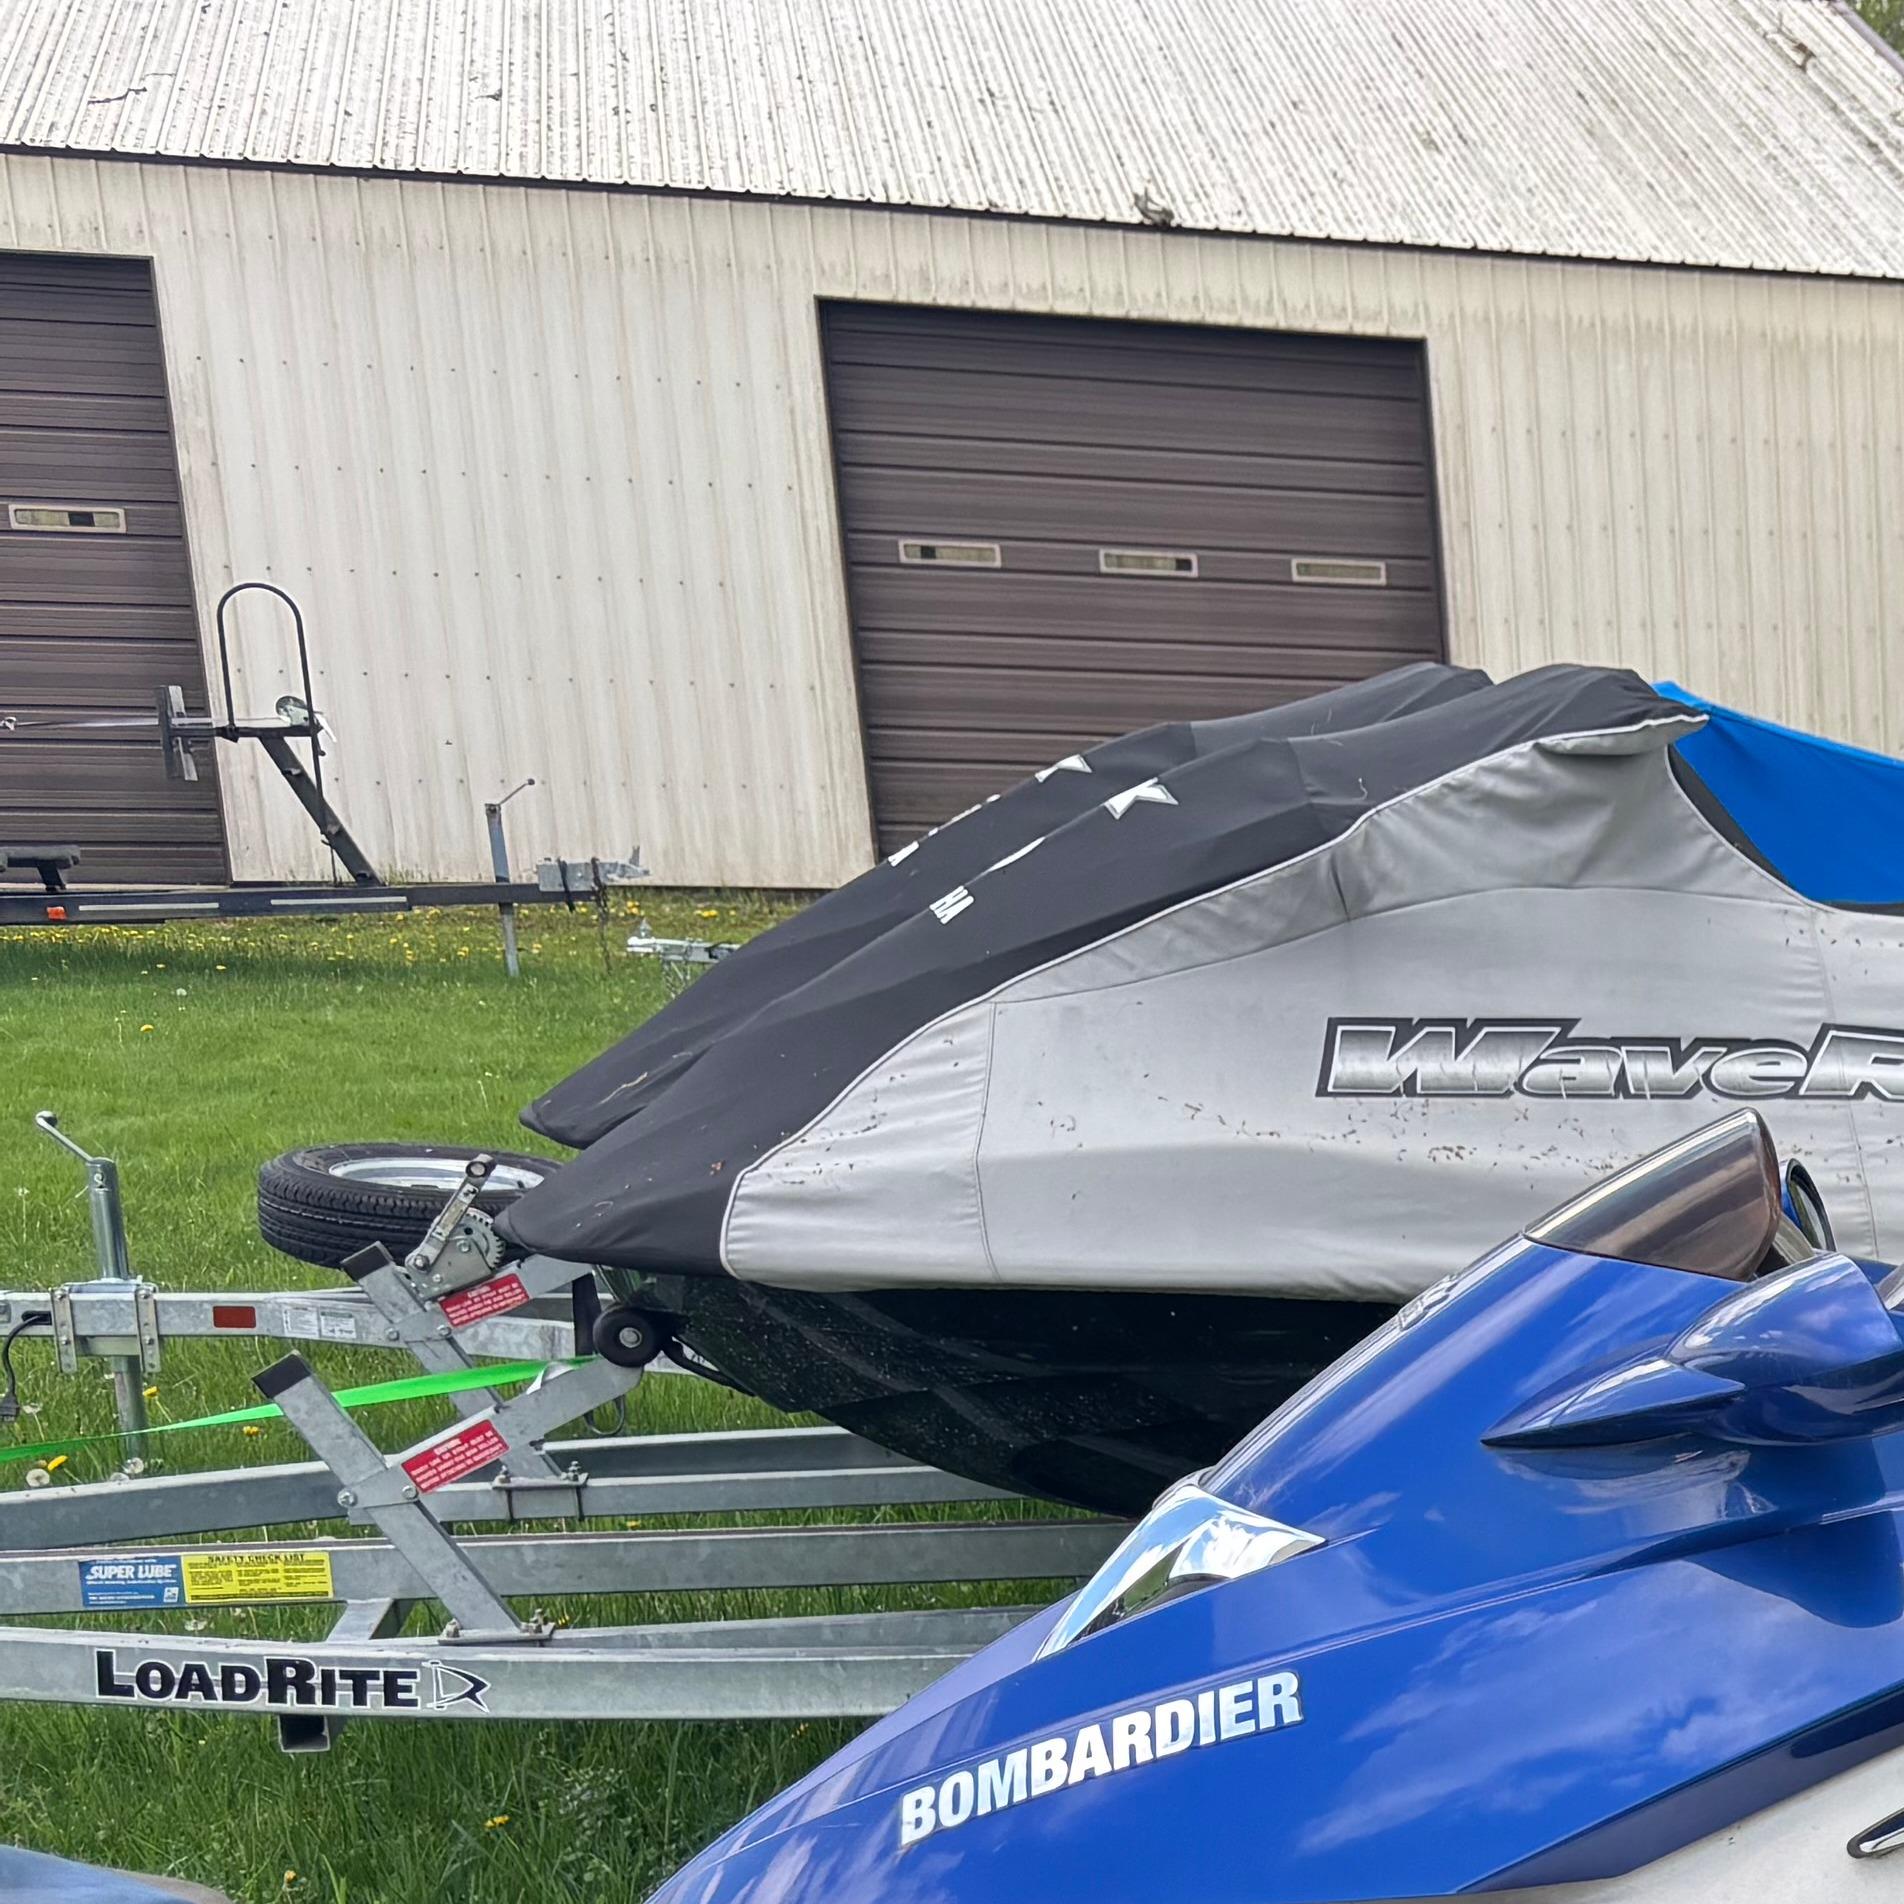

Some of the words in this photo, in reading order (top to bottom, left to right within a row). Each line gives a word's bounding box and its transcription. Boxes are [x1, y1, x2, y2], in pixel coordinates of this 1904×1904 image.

[85, 1564, 135, 1580] SUPER
[137, 1564, 177, 1579] LUBE
[901, 1670, 1304, 1846] BOMBARDIER
